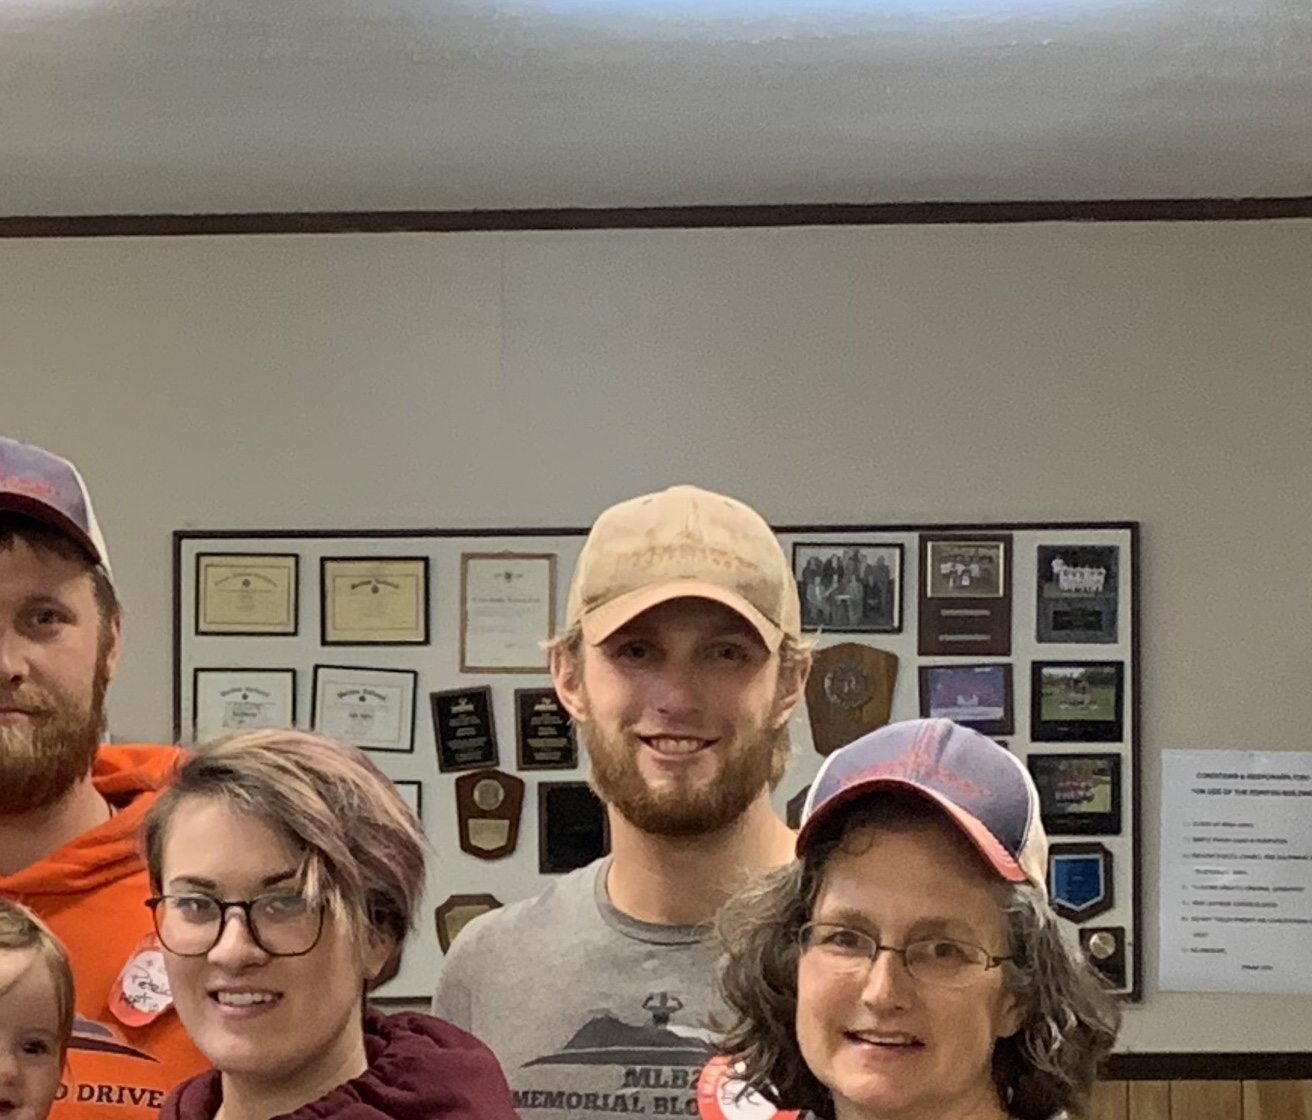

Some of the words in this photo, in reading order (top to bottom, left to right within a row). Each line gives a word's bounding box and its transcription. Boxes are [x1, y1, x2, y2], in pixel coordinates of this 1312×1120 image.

[77, 1083, 164, 1109] DRIVE
[513, 1090, 645, 1114] MEMORIAL
[653, 1096, 699, 1116] BLO
